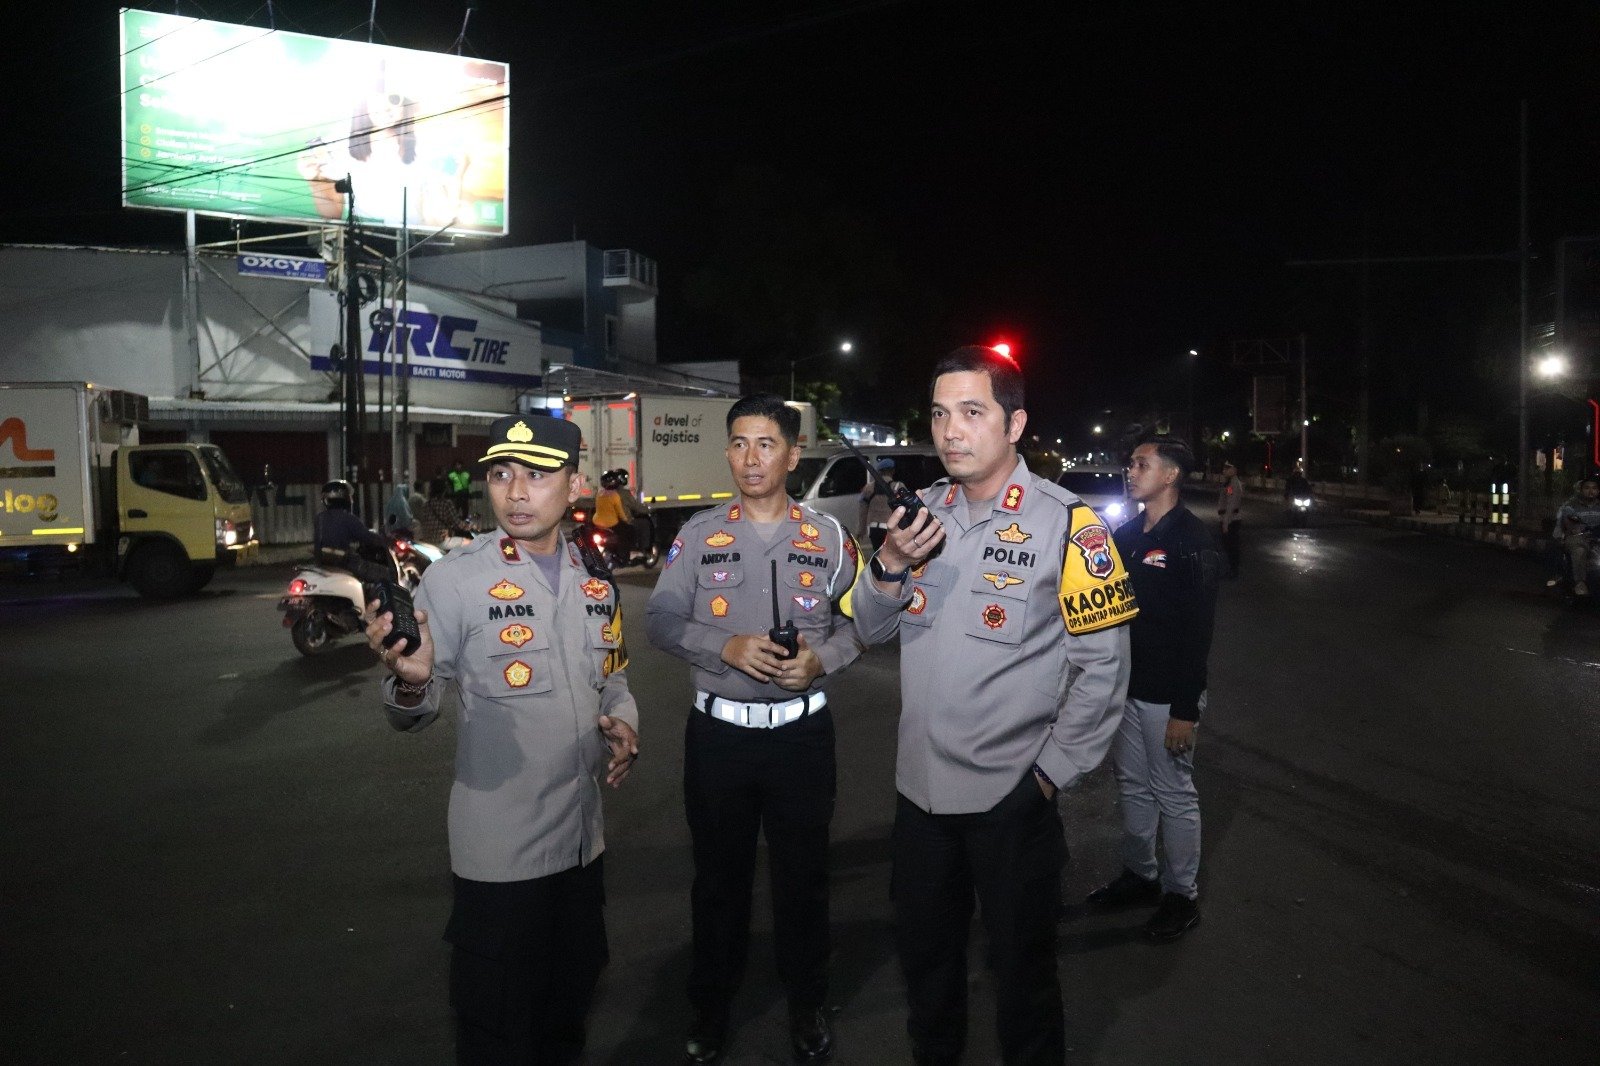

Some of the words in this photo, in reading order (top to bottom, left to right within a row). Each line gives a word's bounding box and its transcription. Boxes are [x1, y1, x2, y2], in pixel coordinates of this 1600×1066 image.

[243, 256, 304, 271] OXCY
[471, 337, 510, 365] TIRE
[413, 366, 436, 378] BAKTI
[439, 367, 467, 380] MOTOR
[653, 415, 661, 427] a
[664, 413, 689, 427] level
[691, 413, 703, 427] of
[652, 429, 700, 446] logistics
[787, 552, 829, 569] POLRI
[983, 546, 1037, 568] POLRI
[488, 604, 535, 621] MADE
[1068, 617, 1083, 629] OPS
[1083, 609, 1108, 626] MANTAP
